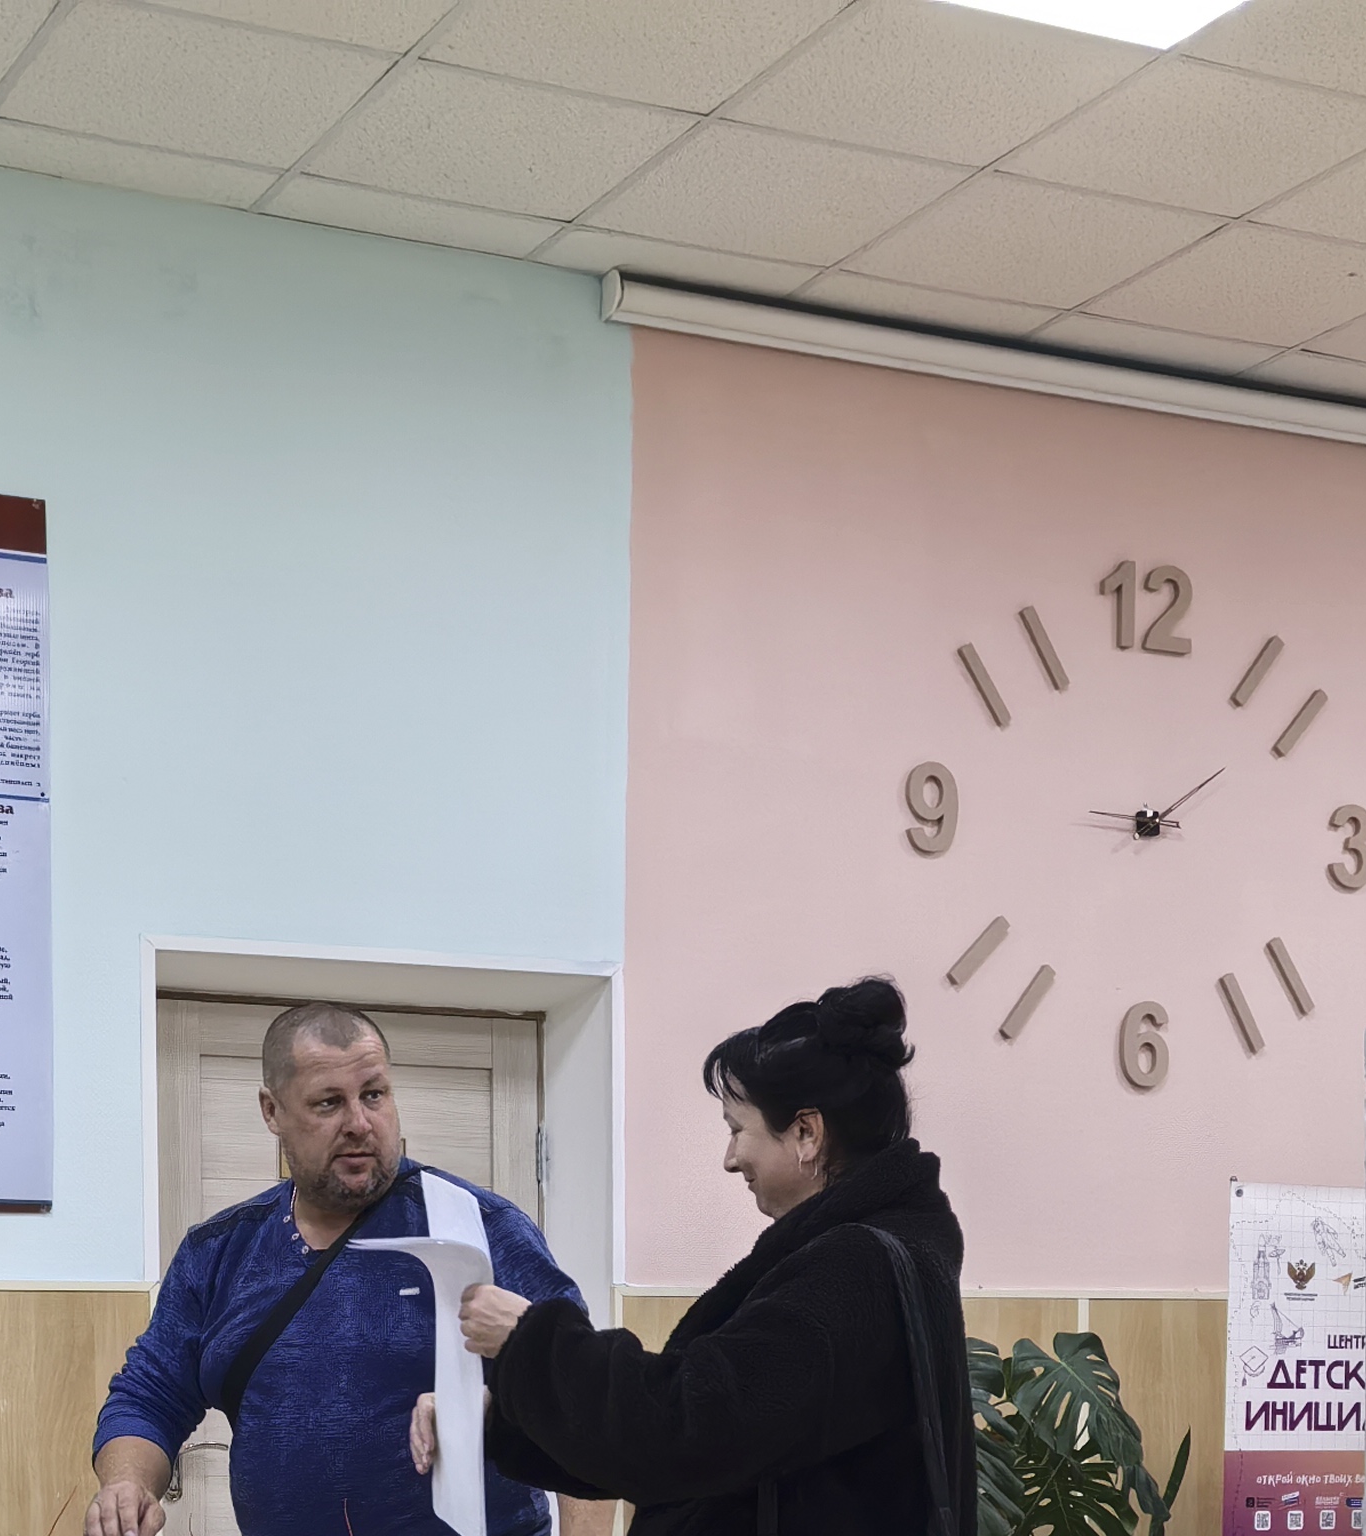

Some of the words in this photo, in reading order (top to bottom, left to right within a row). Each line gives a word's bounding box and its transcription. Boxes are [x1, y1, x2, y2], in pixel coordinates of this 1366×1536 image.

[1099, 559, 1194, 656] 12
[904, 760, 959, 859] 9
[1118, 1000, 1170, 1090] 6
[1267, 1359, 1366, 1390] ДЕТСК
[1244, 1400, 1366, 1432] ИНИЦИ
[1256, 1471, 1293, 1487] ОТКРОЙ
[1296, 1475, 1321, 1487] ОКНО
[1323, 1474, 1352, 1487] ТВОИХ
